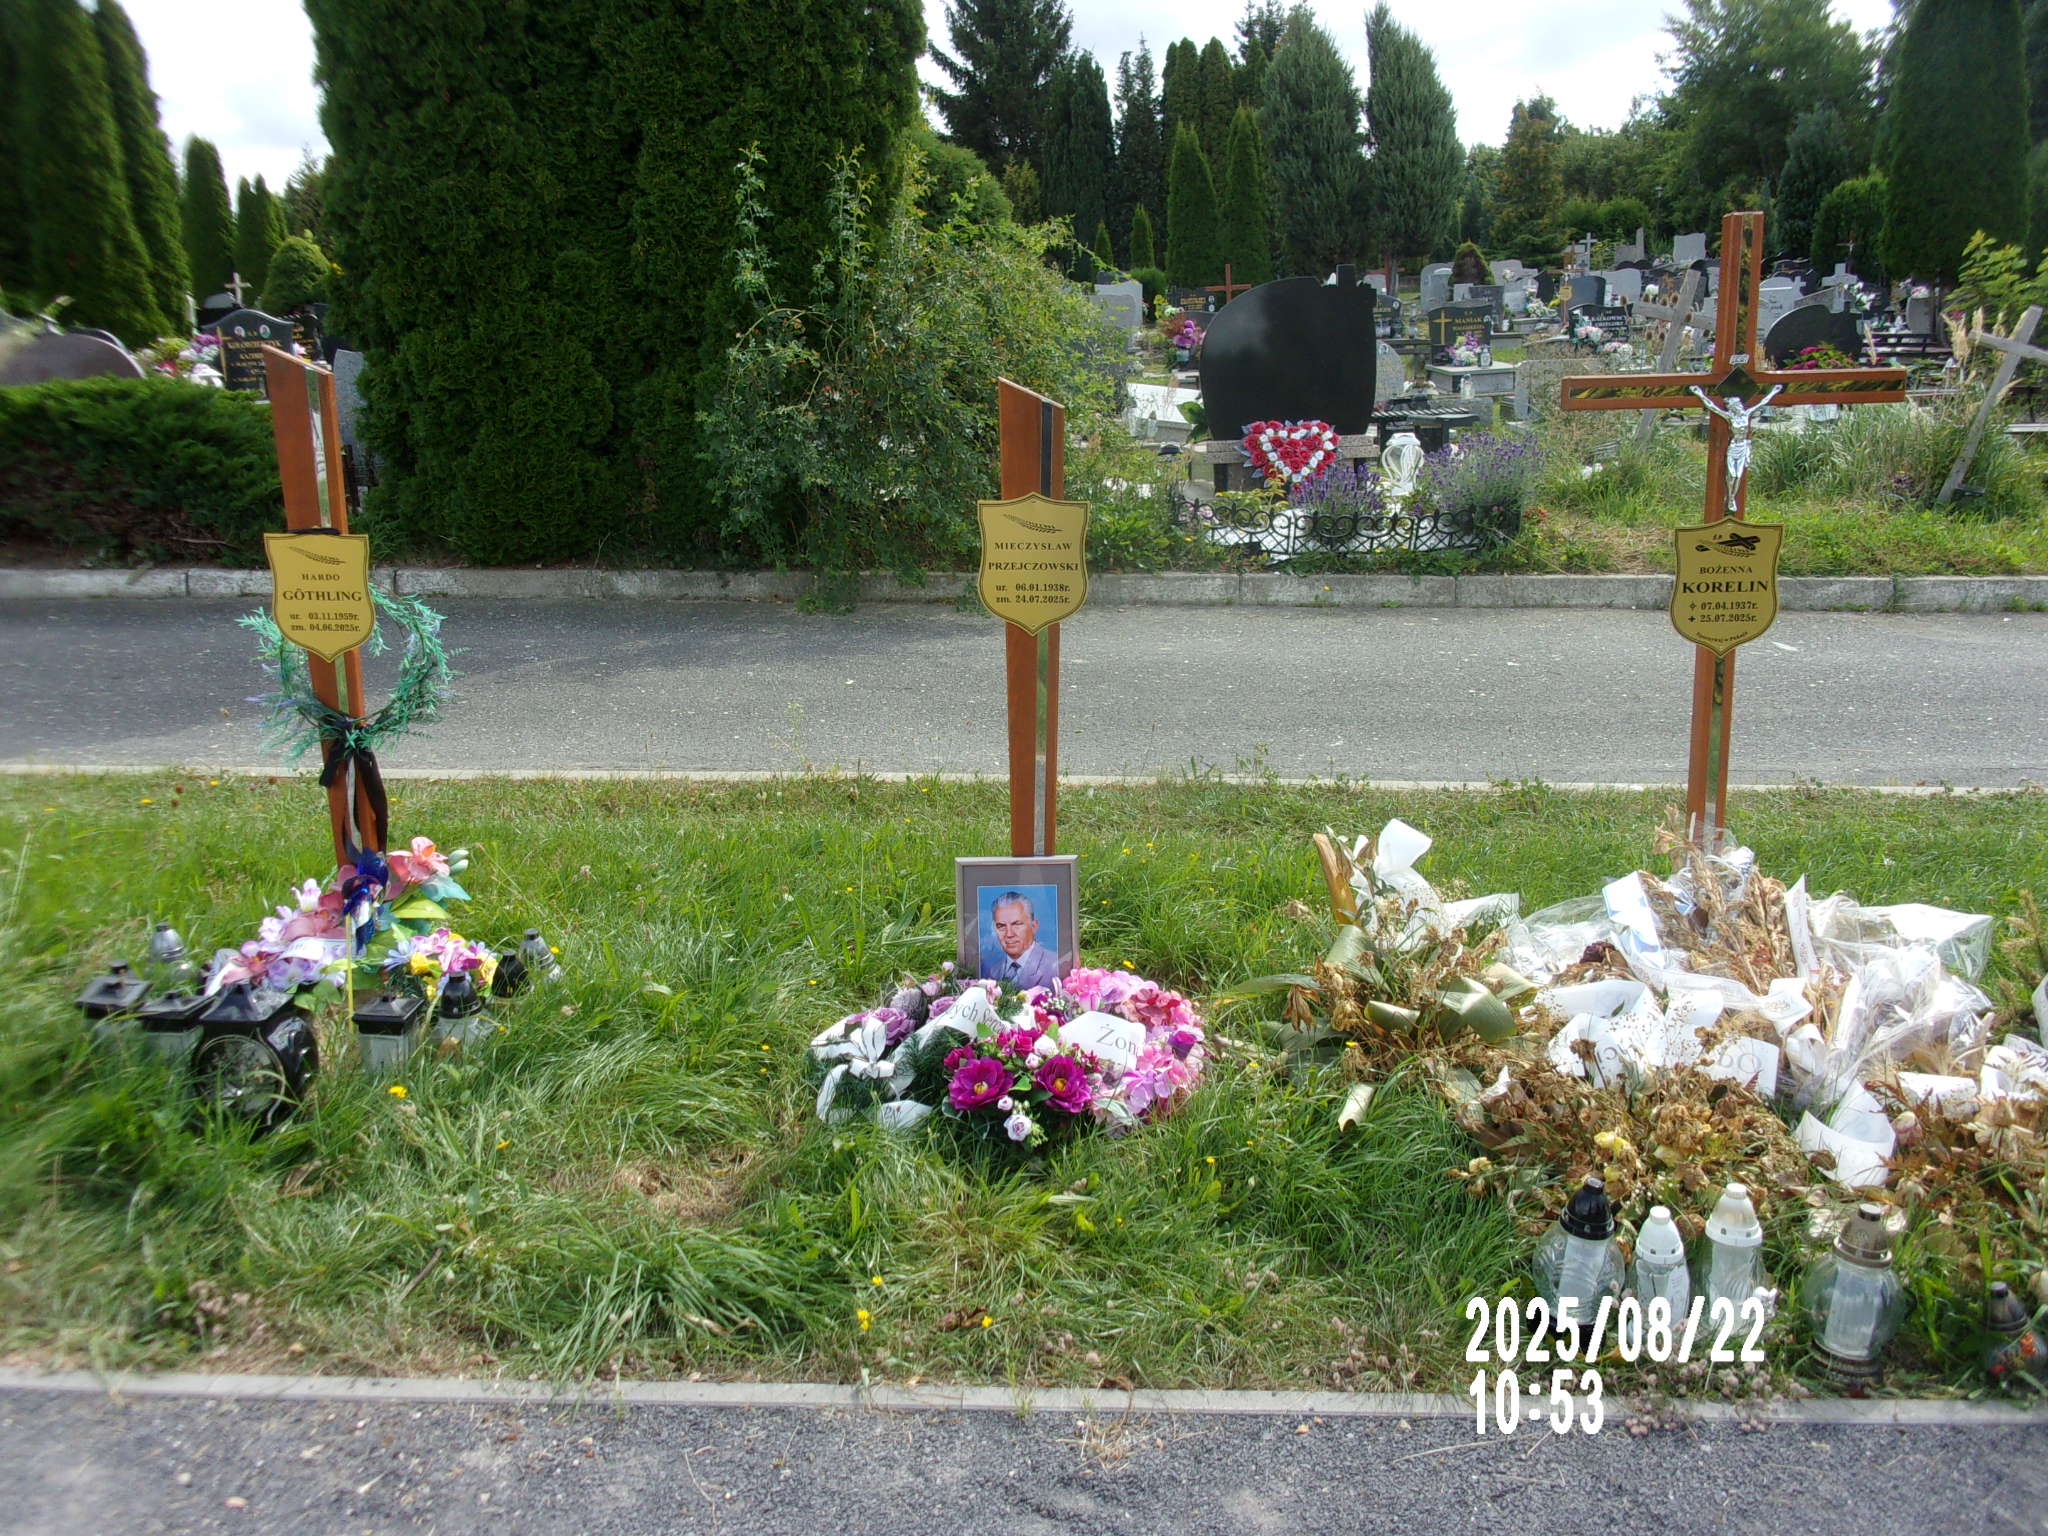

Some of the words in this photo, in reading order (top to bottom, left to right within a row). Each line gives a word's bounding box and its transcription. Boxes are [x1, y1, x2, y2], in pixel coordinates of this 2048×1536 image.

[988, 562, 1079, 572] PRZEJCZOWSKI
[1699, 564, 1753, 575] BOŻENNA
[301, 573, 341, 581] HARDO
[1681, 580, 1769, 594] KORELIN
[282, 588, 362, 602] GÖTHLING
[1015, 595, 1071, 604] 24.07.2025r.
